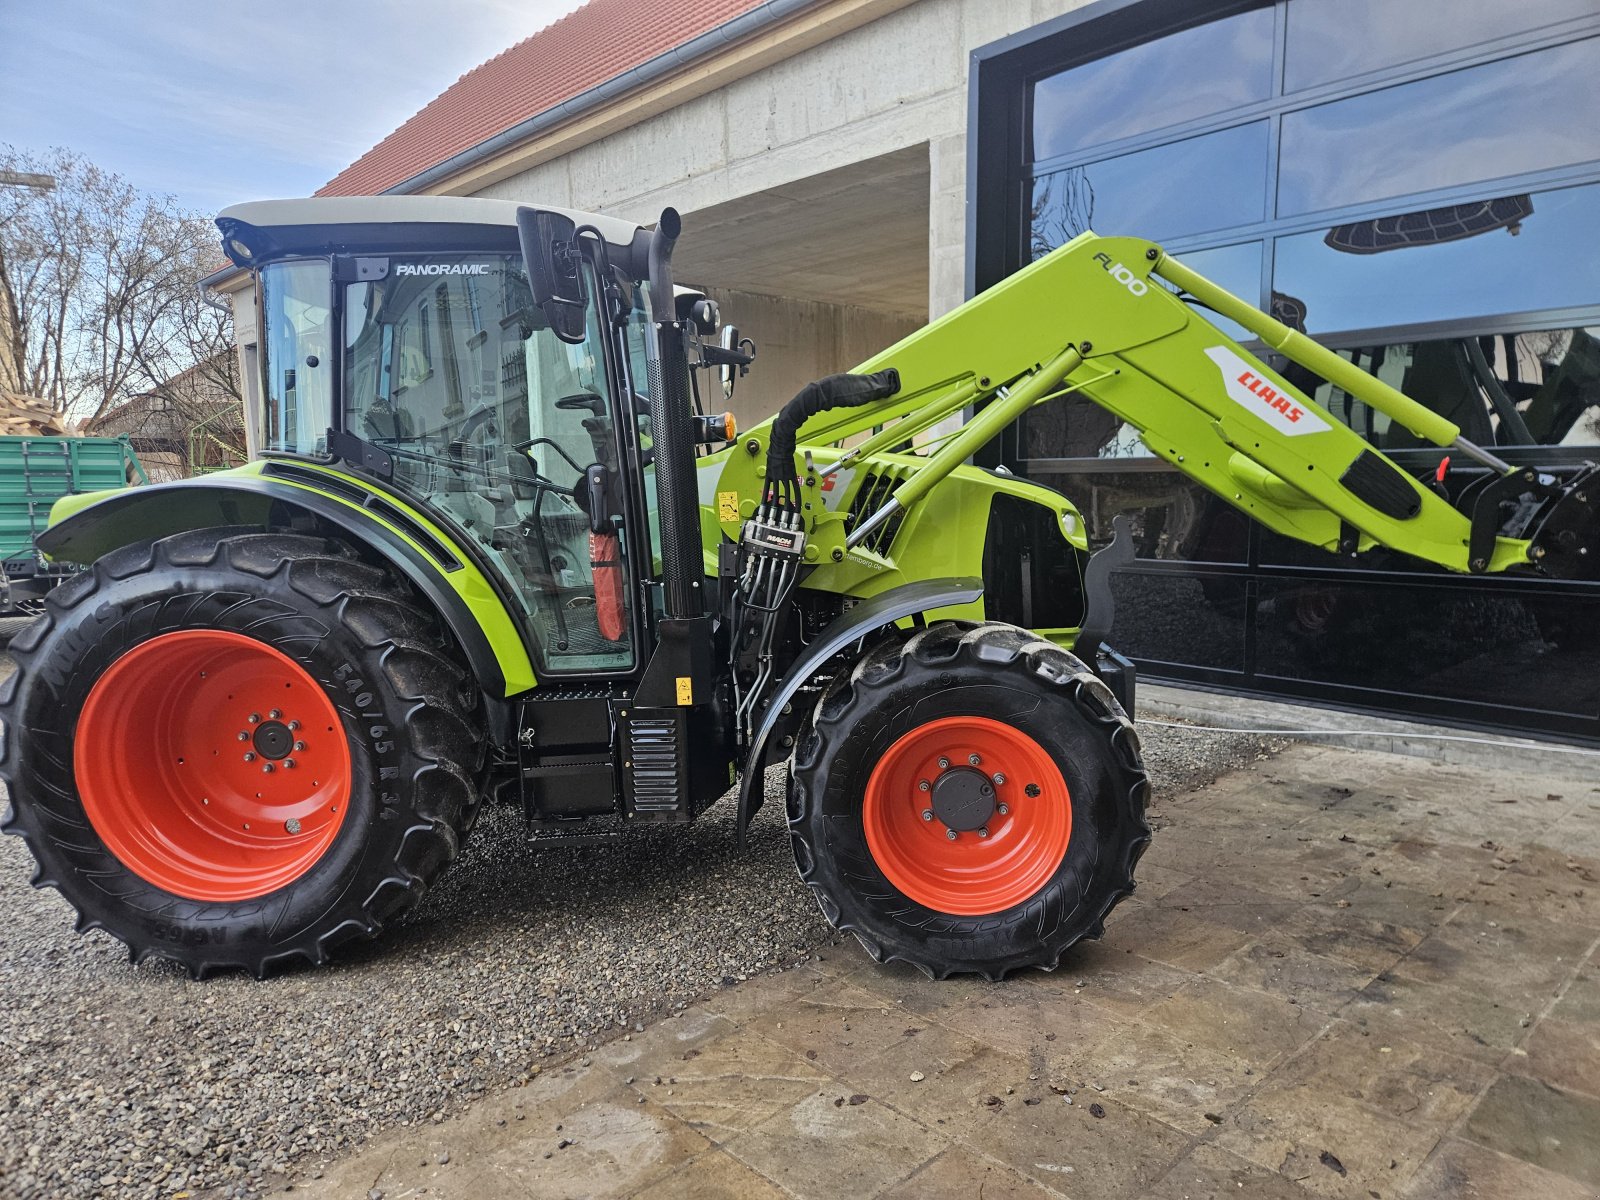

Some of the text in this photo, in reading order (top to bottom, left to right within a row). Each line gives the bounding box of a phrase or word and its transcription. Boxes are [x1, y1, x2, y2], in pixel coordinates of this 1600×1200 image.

[396, 264, 490, 276] PANORAMIC
[1092, 252, 1148, 297] FL100
[1237, 371, 1305, 423] CLAAS
[333, 663, 396, 754] 540/65
